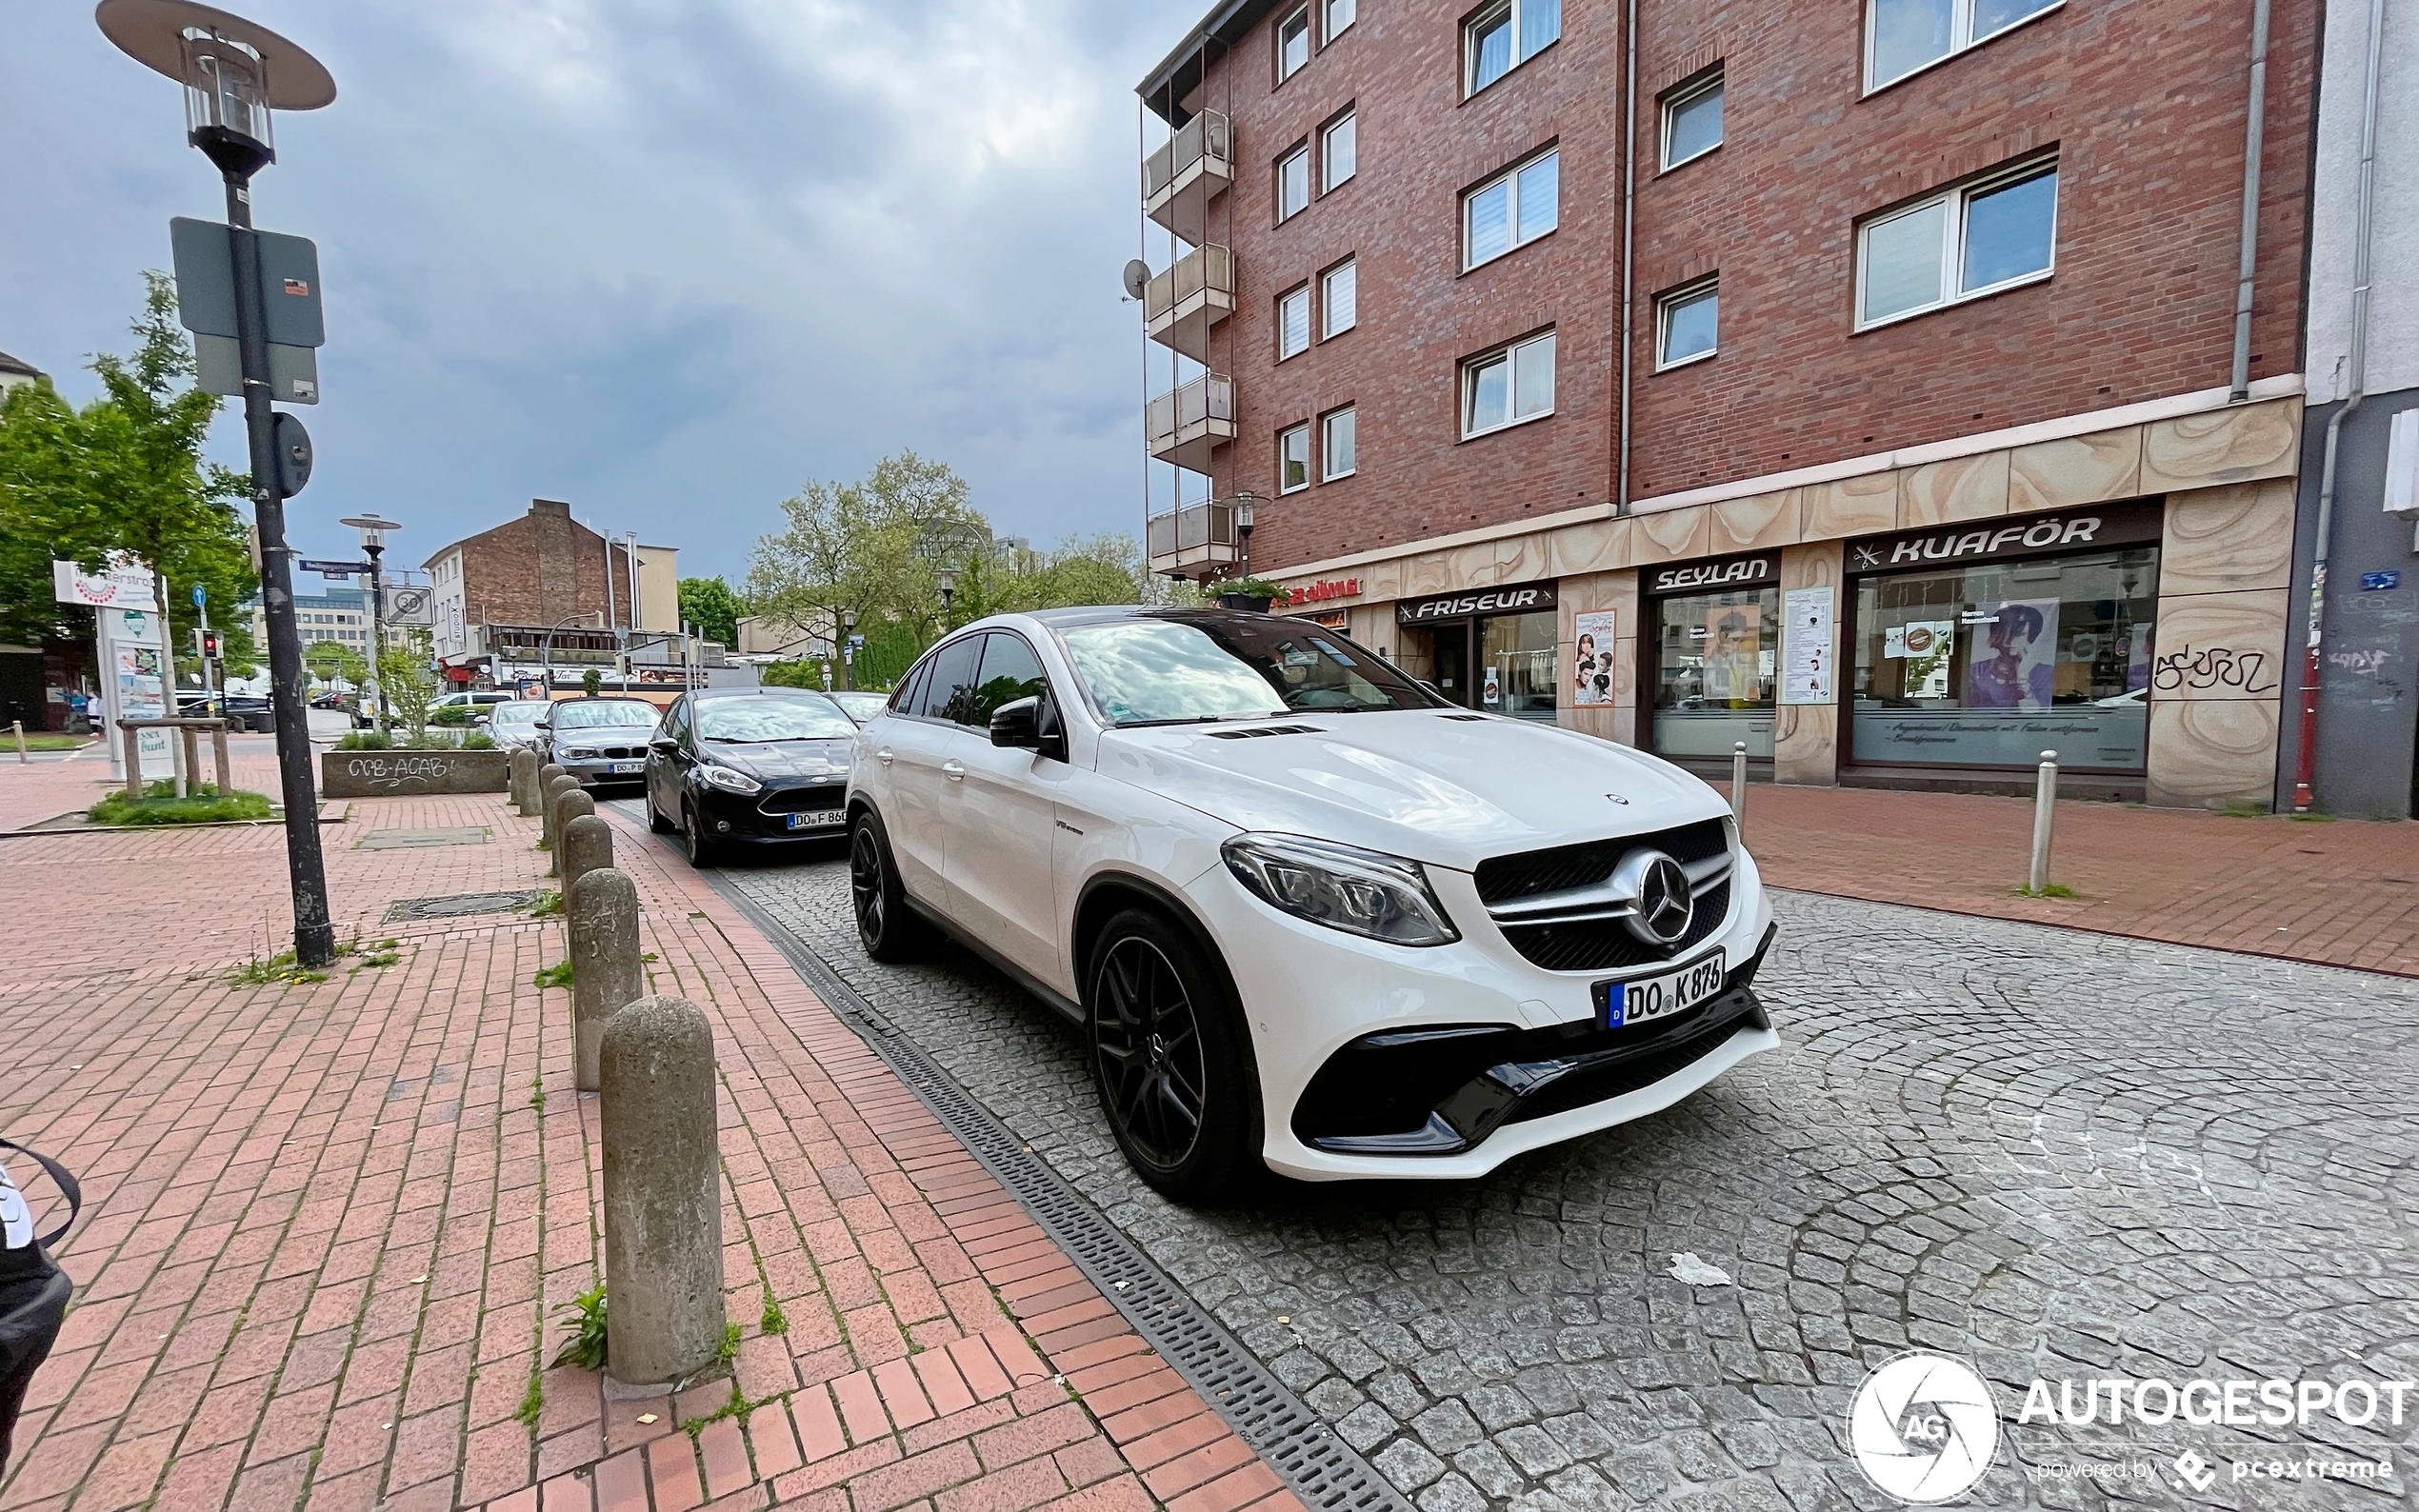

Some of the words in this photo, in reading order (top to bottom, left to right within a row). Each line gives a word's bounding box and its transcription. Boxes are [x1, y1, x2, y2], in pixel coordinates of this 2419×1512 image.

[1889, 517, 2102, 564] KUAFÖR
[1655, 559, 1769, 590] SEYLAN
[400, 597, 418, 608] 30
[1416, 588, 1538, 618] FRISEUR
[796, 814, 810, 826] DO
[818, 813, 826, 824] F
[1613, 1009, 1621, 1020] D
[1627, 982, 1663, 1020] DO
[1675, 973, 1689, 1008] K
[1690, 958, 1721, 1000] 876
